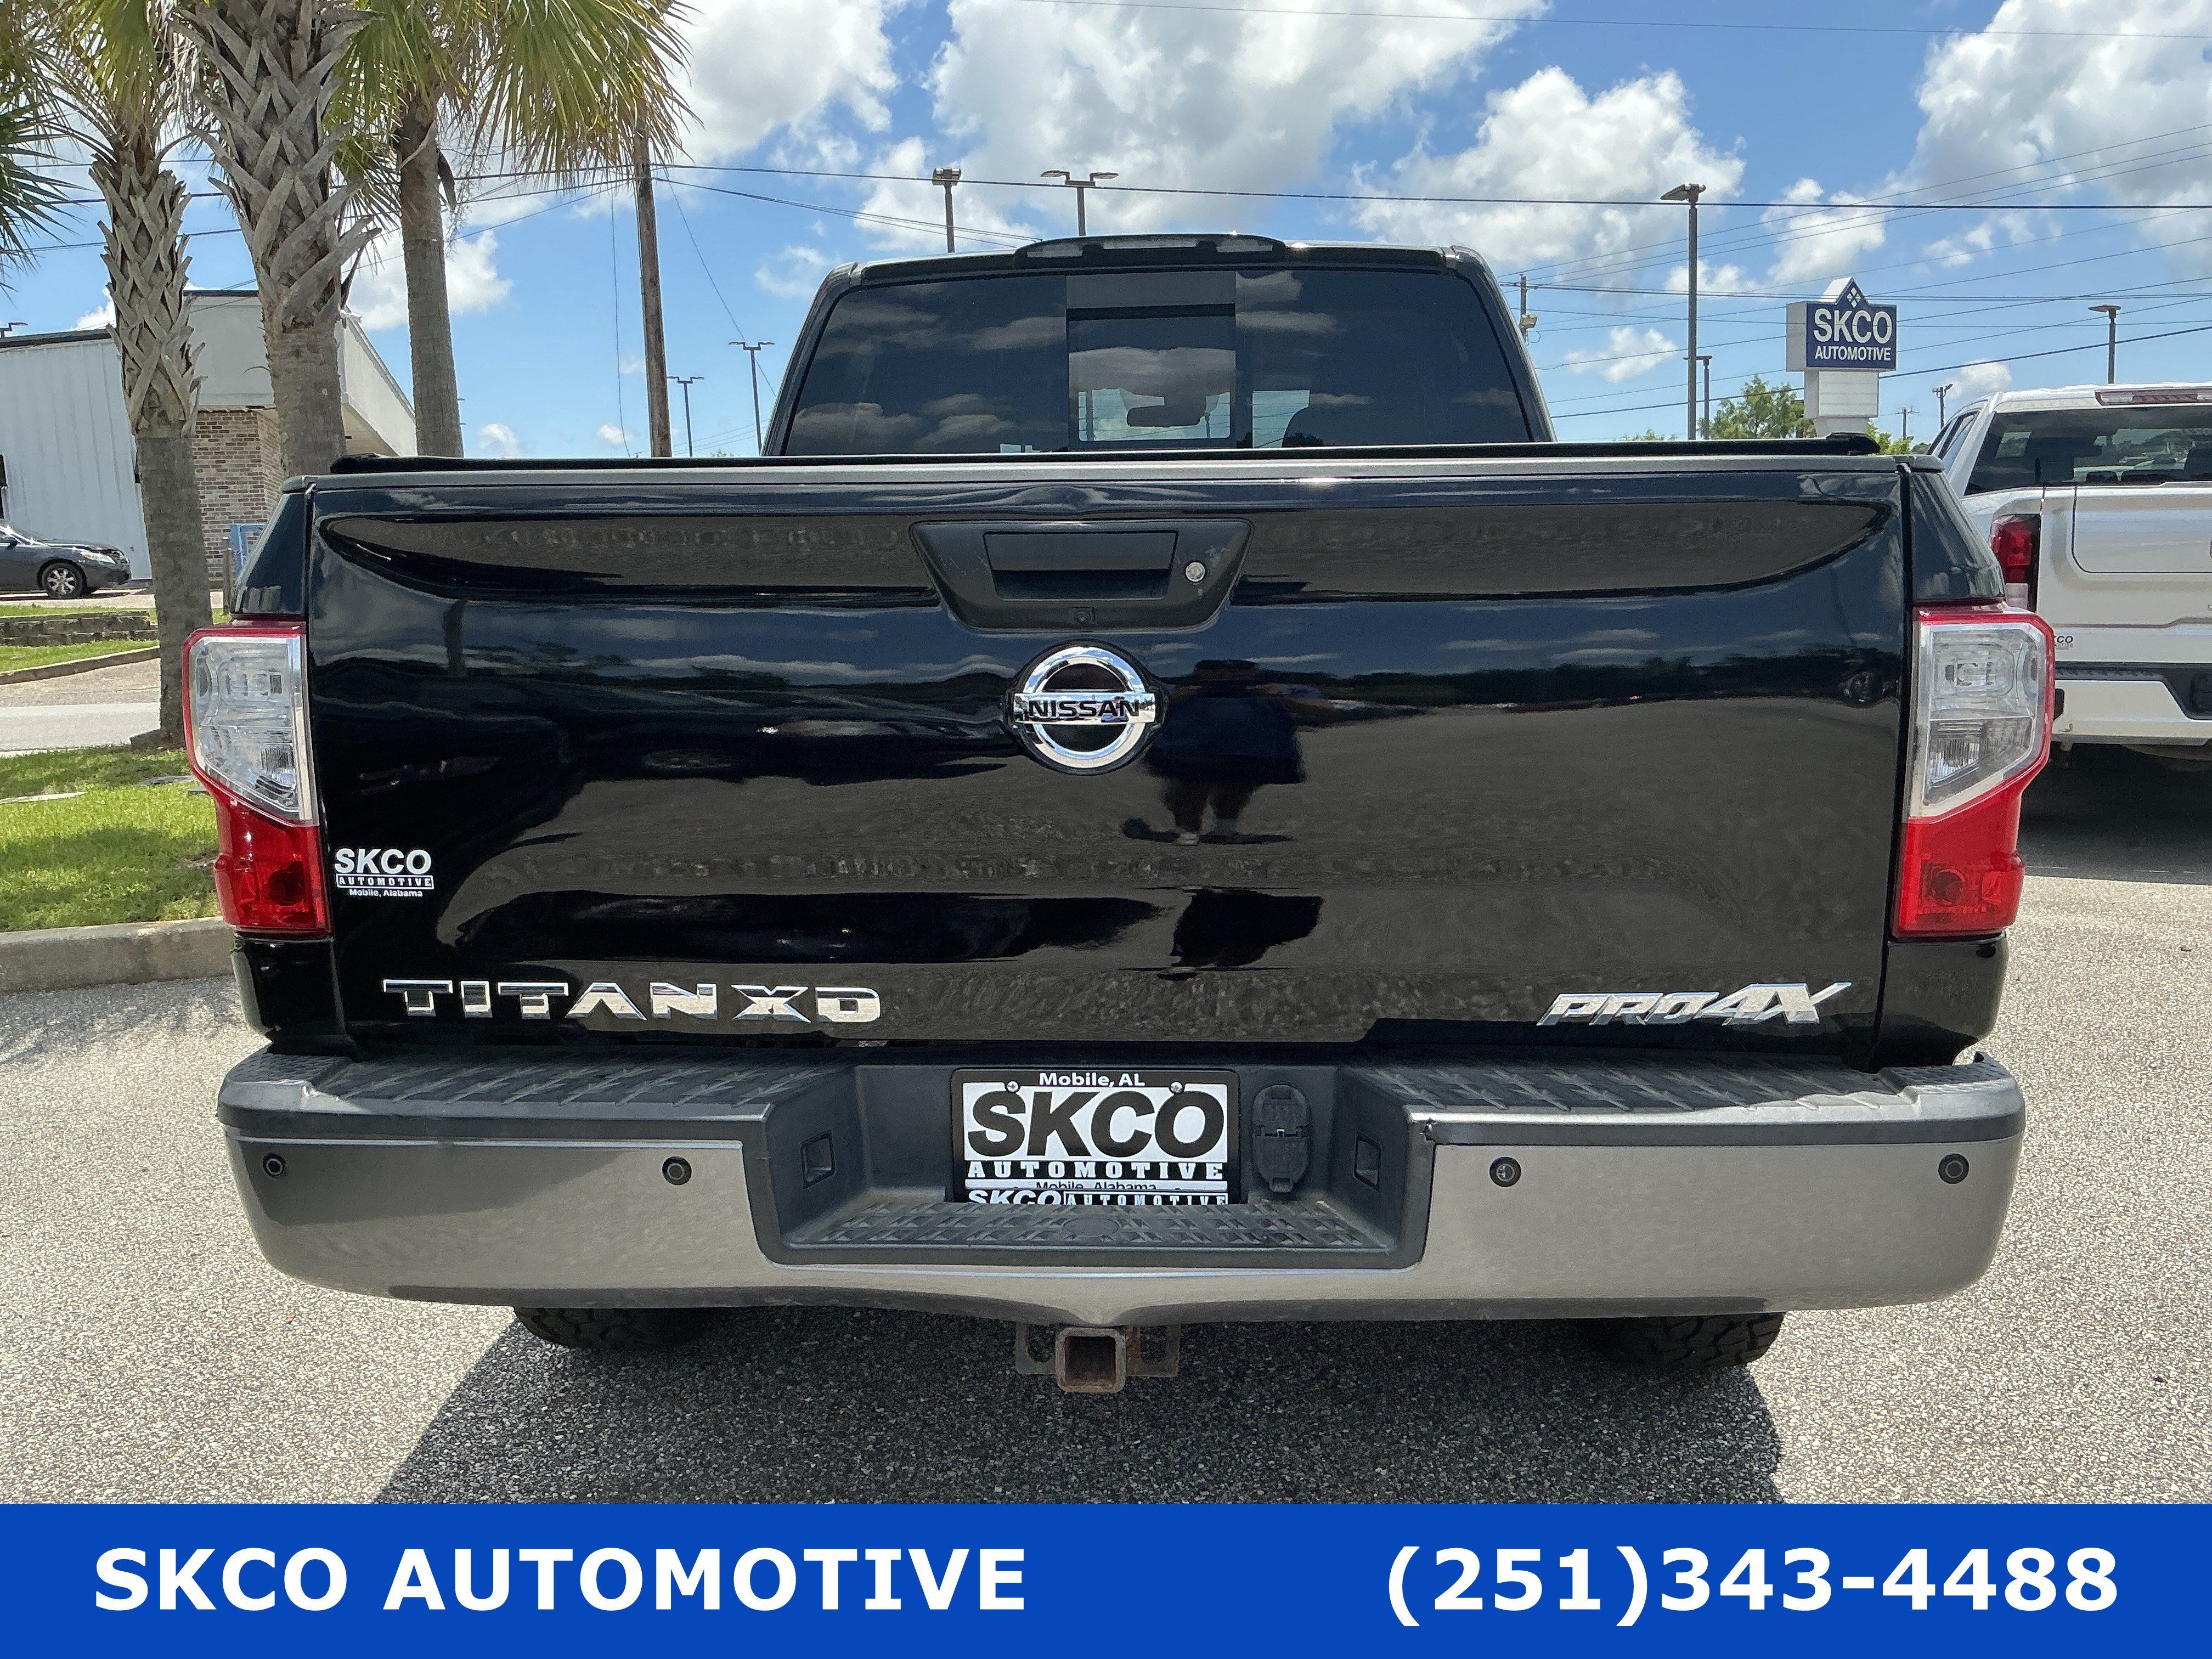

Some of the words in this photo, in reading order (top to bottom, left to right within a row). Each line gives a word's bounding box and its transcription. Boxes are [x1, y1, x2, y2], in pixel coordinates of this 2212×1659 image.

[1814, 308, 1892, 343] SKCO
[1815, 346, 1891, 361] AUTOMOTIVE
[1028, 700, 1139, 717] NISSAN
[334, 848, 432, 874] SKCO
[339, 877, 432, 886] AUTOMOTIVE
[349, 889, 381, 897] Mobile,
[383, 979, 718, 1021] TITAN
[731, 985, 881, 1023] XD
[1039, 1073, 1115, 1087] Mobile,
[1119, 1074, 1146, 1086] AL
[968, 1091, 1224, 1158] SKCO
[968, 1161, 1223, 1180] AUTOMOTIVE
[968, 1190, 1062, 1205] SKCO
[1067, 1194, 1226, 1205] AUTOMOTIVE
